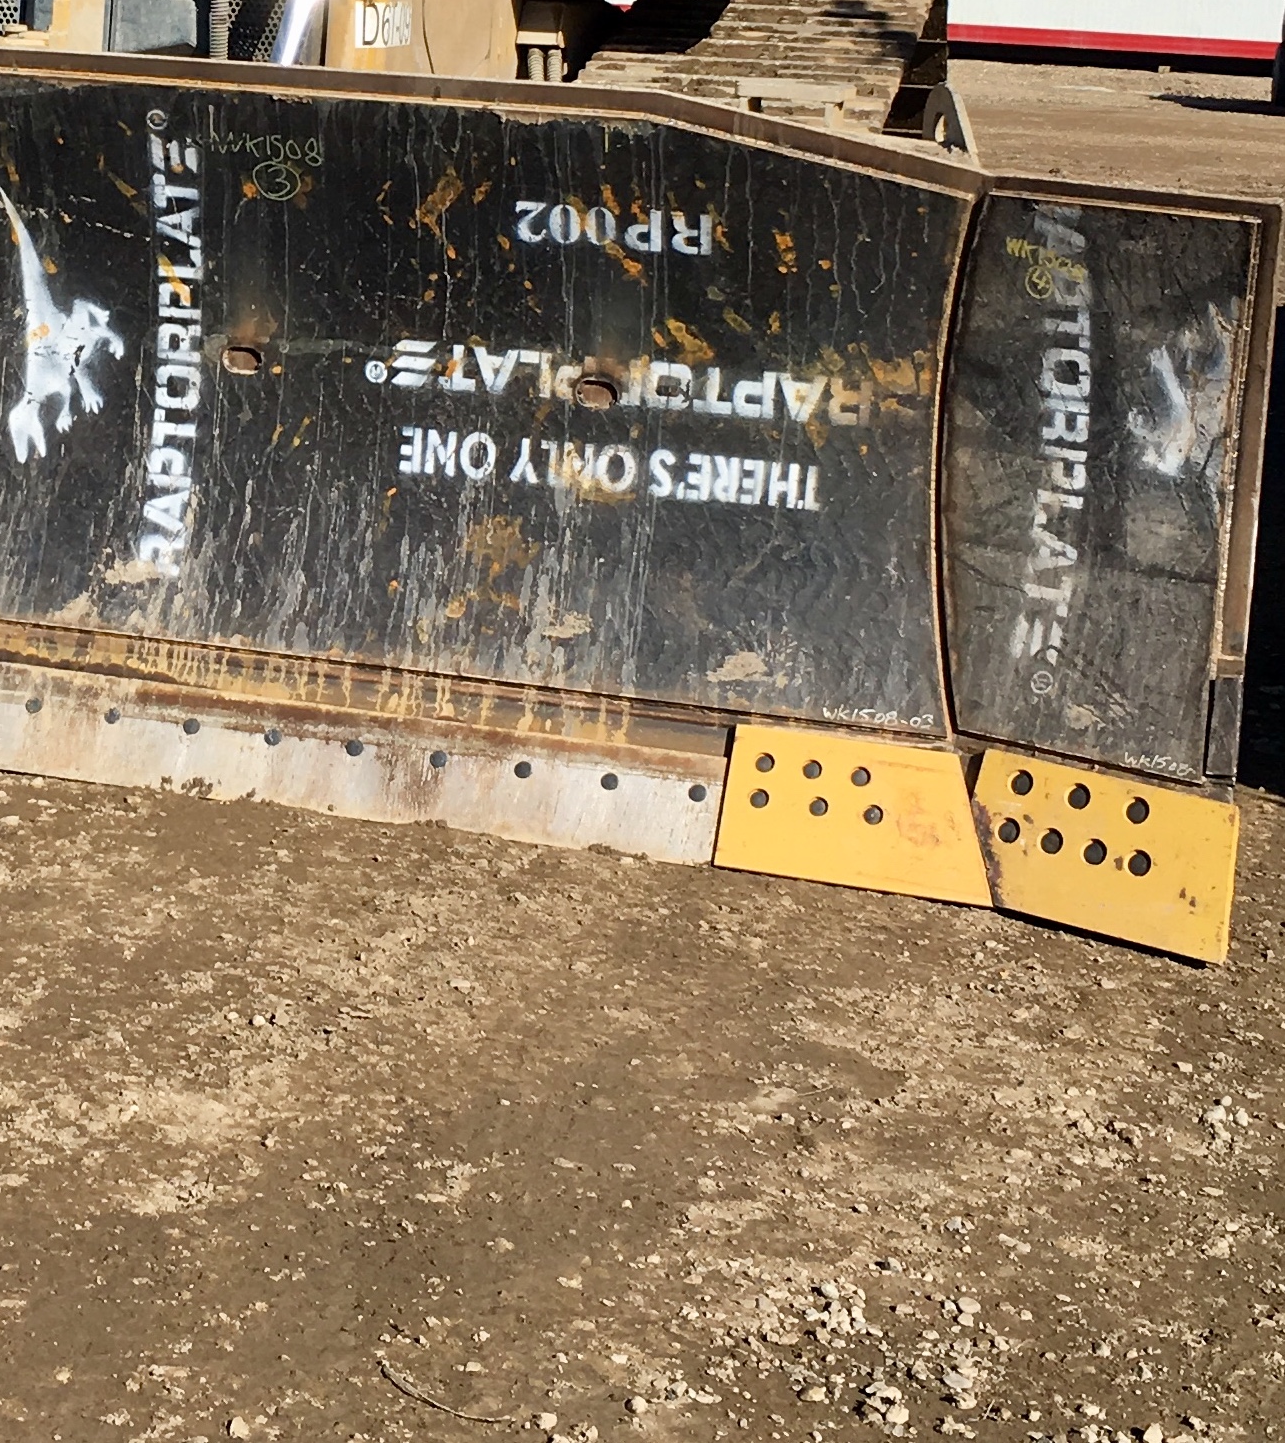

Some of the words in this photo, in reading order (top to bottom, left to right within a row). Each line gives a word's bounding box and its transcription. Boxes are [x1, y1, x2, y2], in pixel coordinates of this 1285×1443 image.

[398, 426, 497, 481] ONE
[510, 436, 636, 494] ONLY
[649, 448, 822, 511] THERE'S
